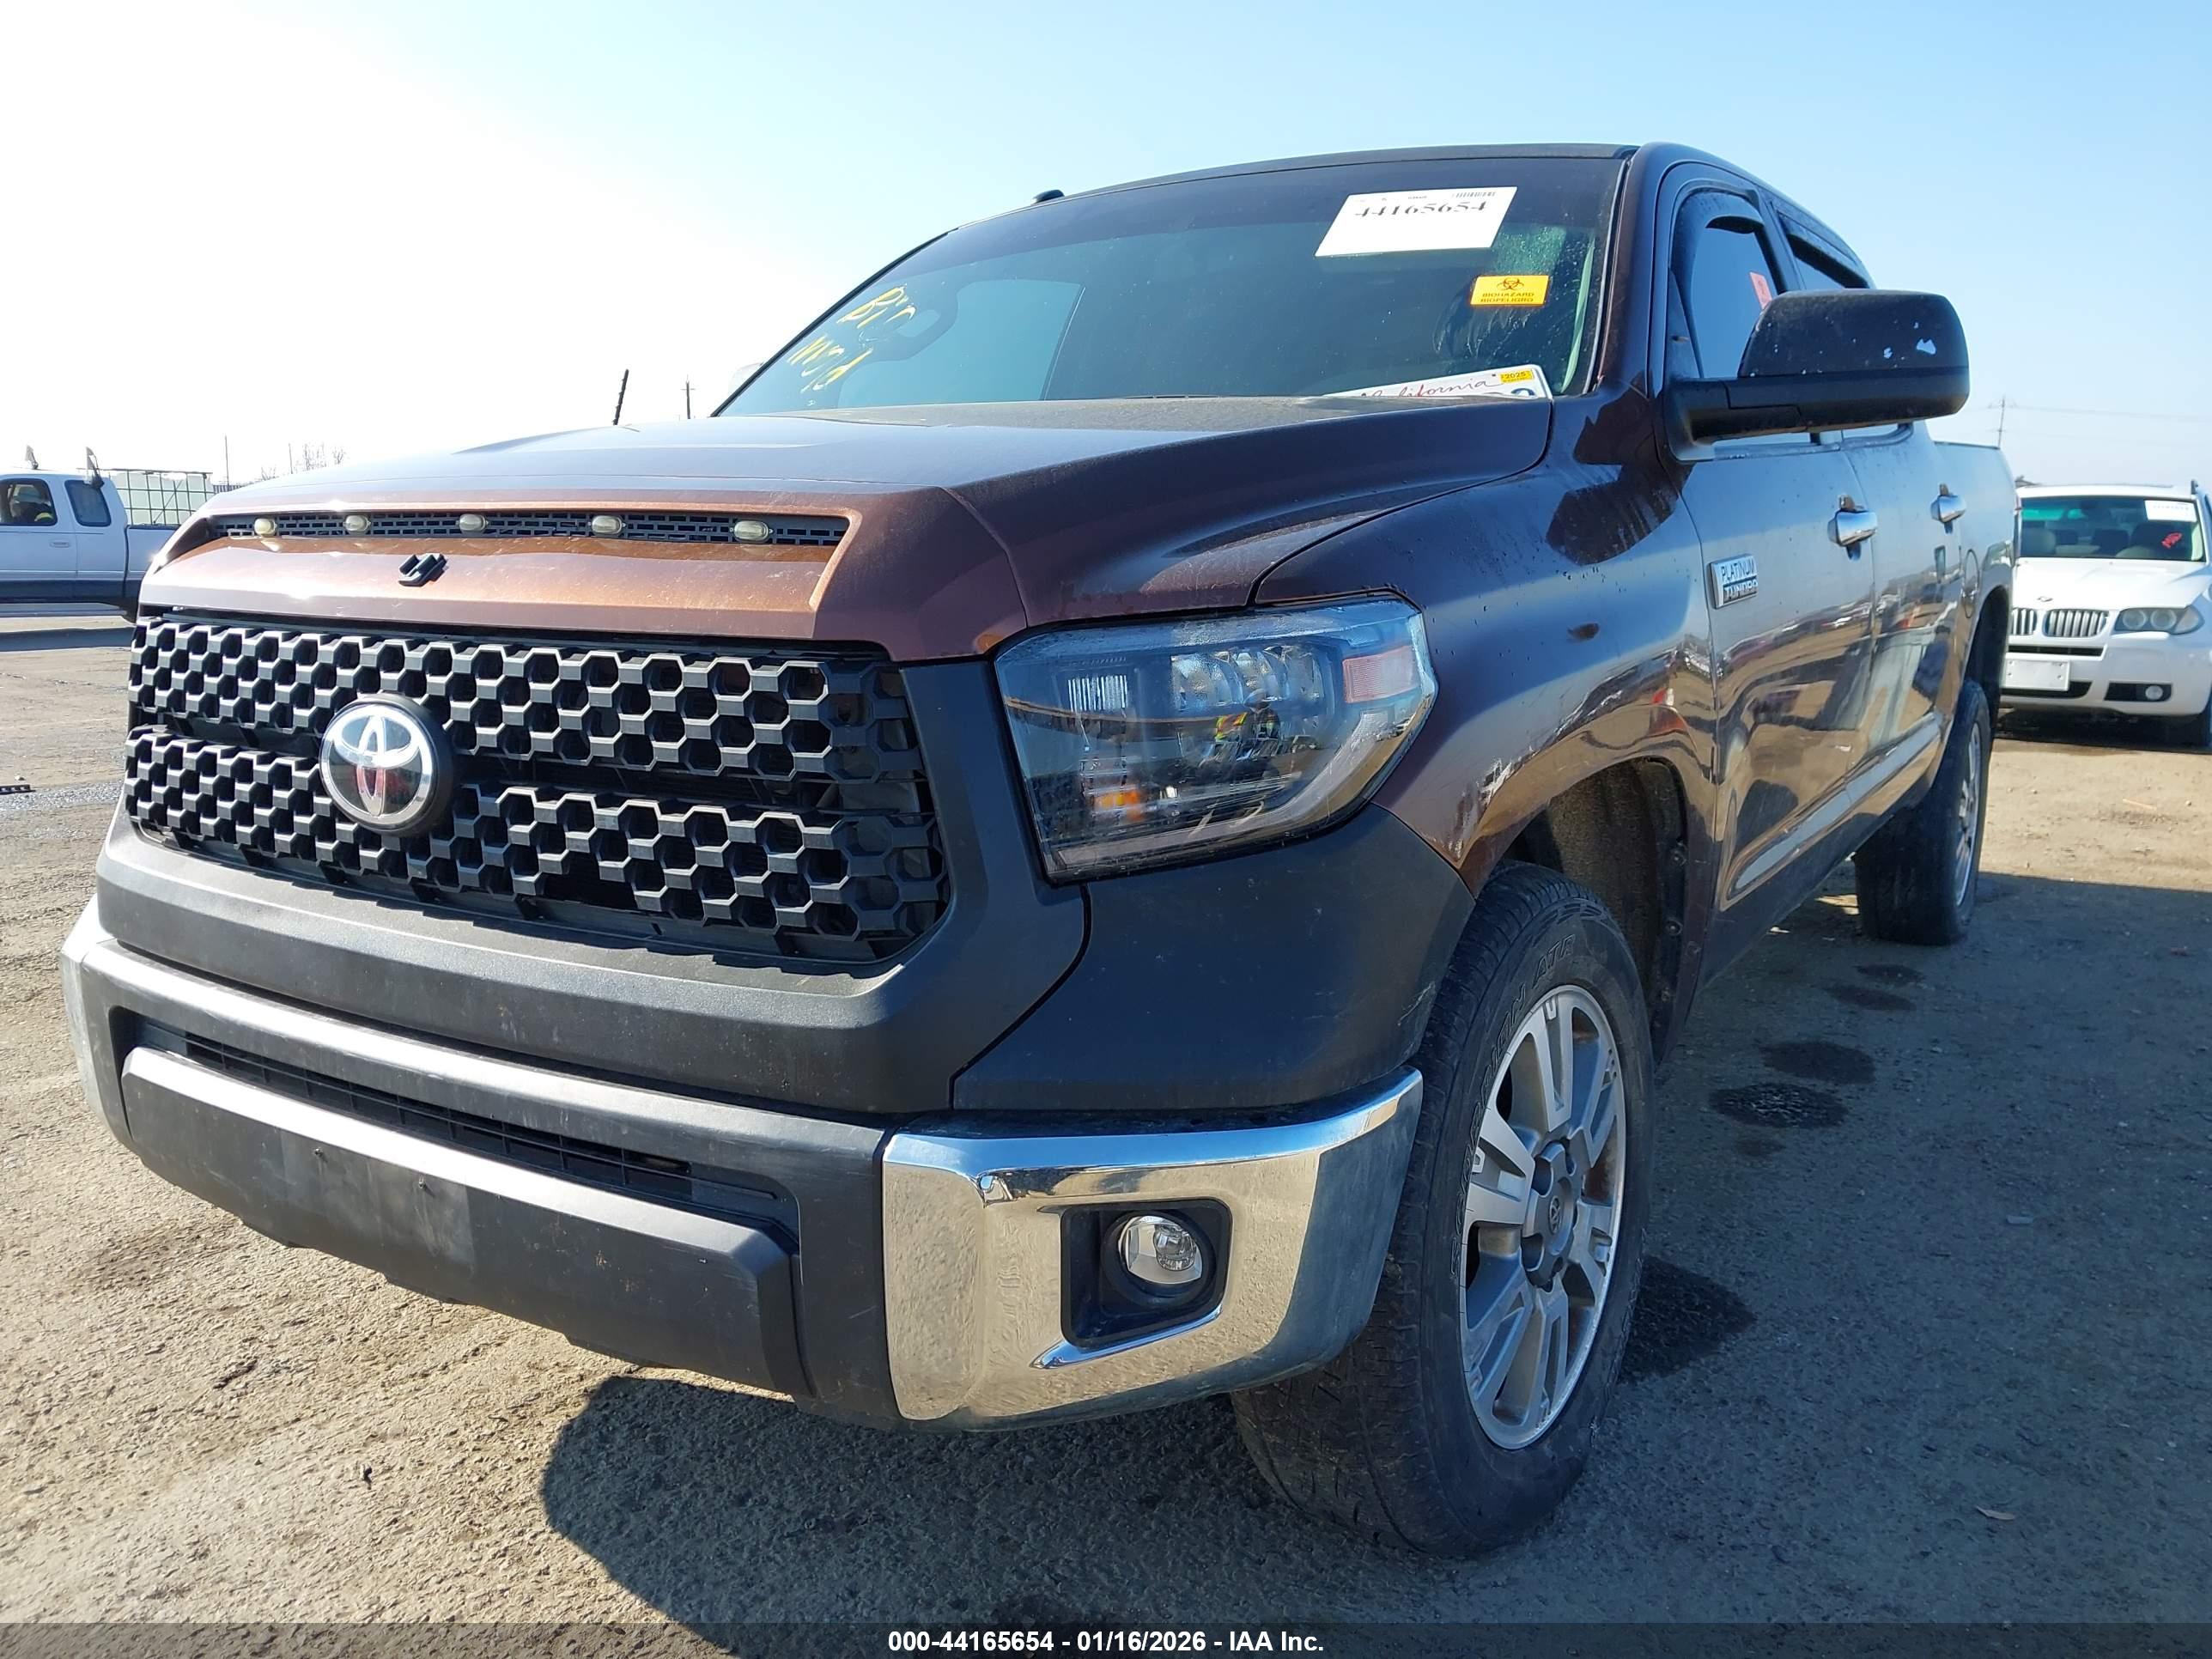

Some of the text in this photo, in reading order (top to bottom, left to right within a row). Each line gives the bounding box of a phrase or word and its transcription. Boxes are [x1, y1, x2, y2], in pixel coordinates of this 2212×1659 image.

[1355, 201, 1486, 217] 44165654
[1504, 371, 1527, 380] 2025
[1720, 557, 1755, 582] PLATINUM
